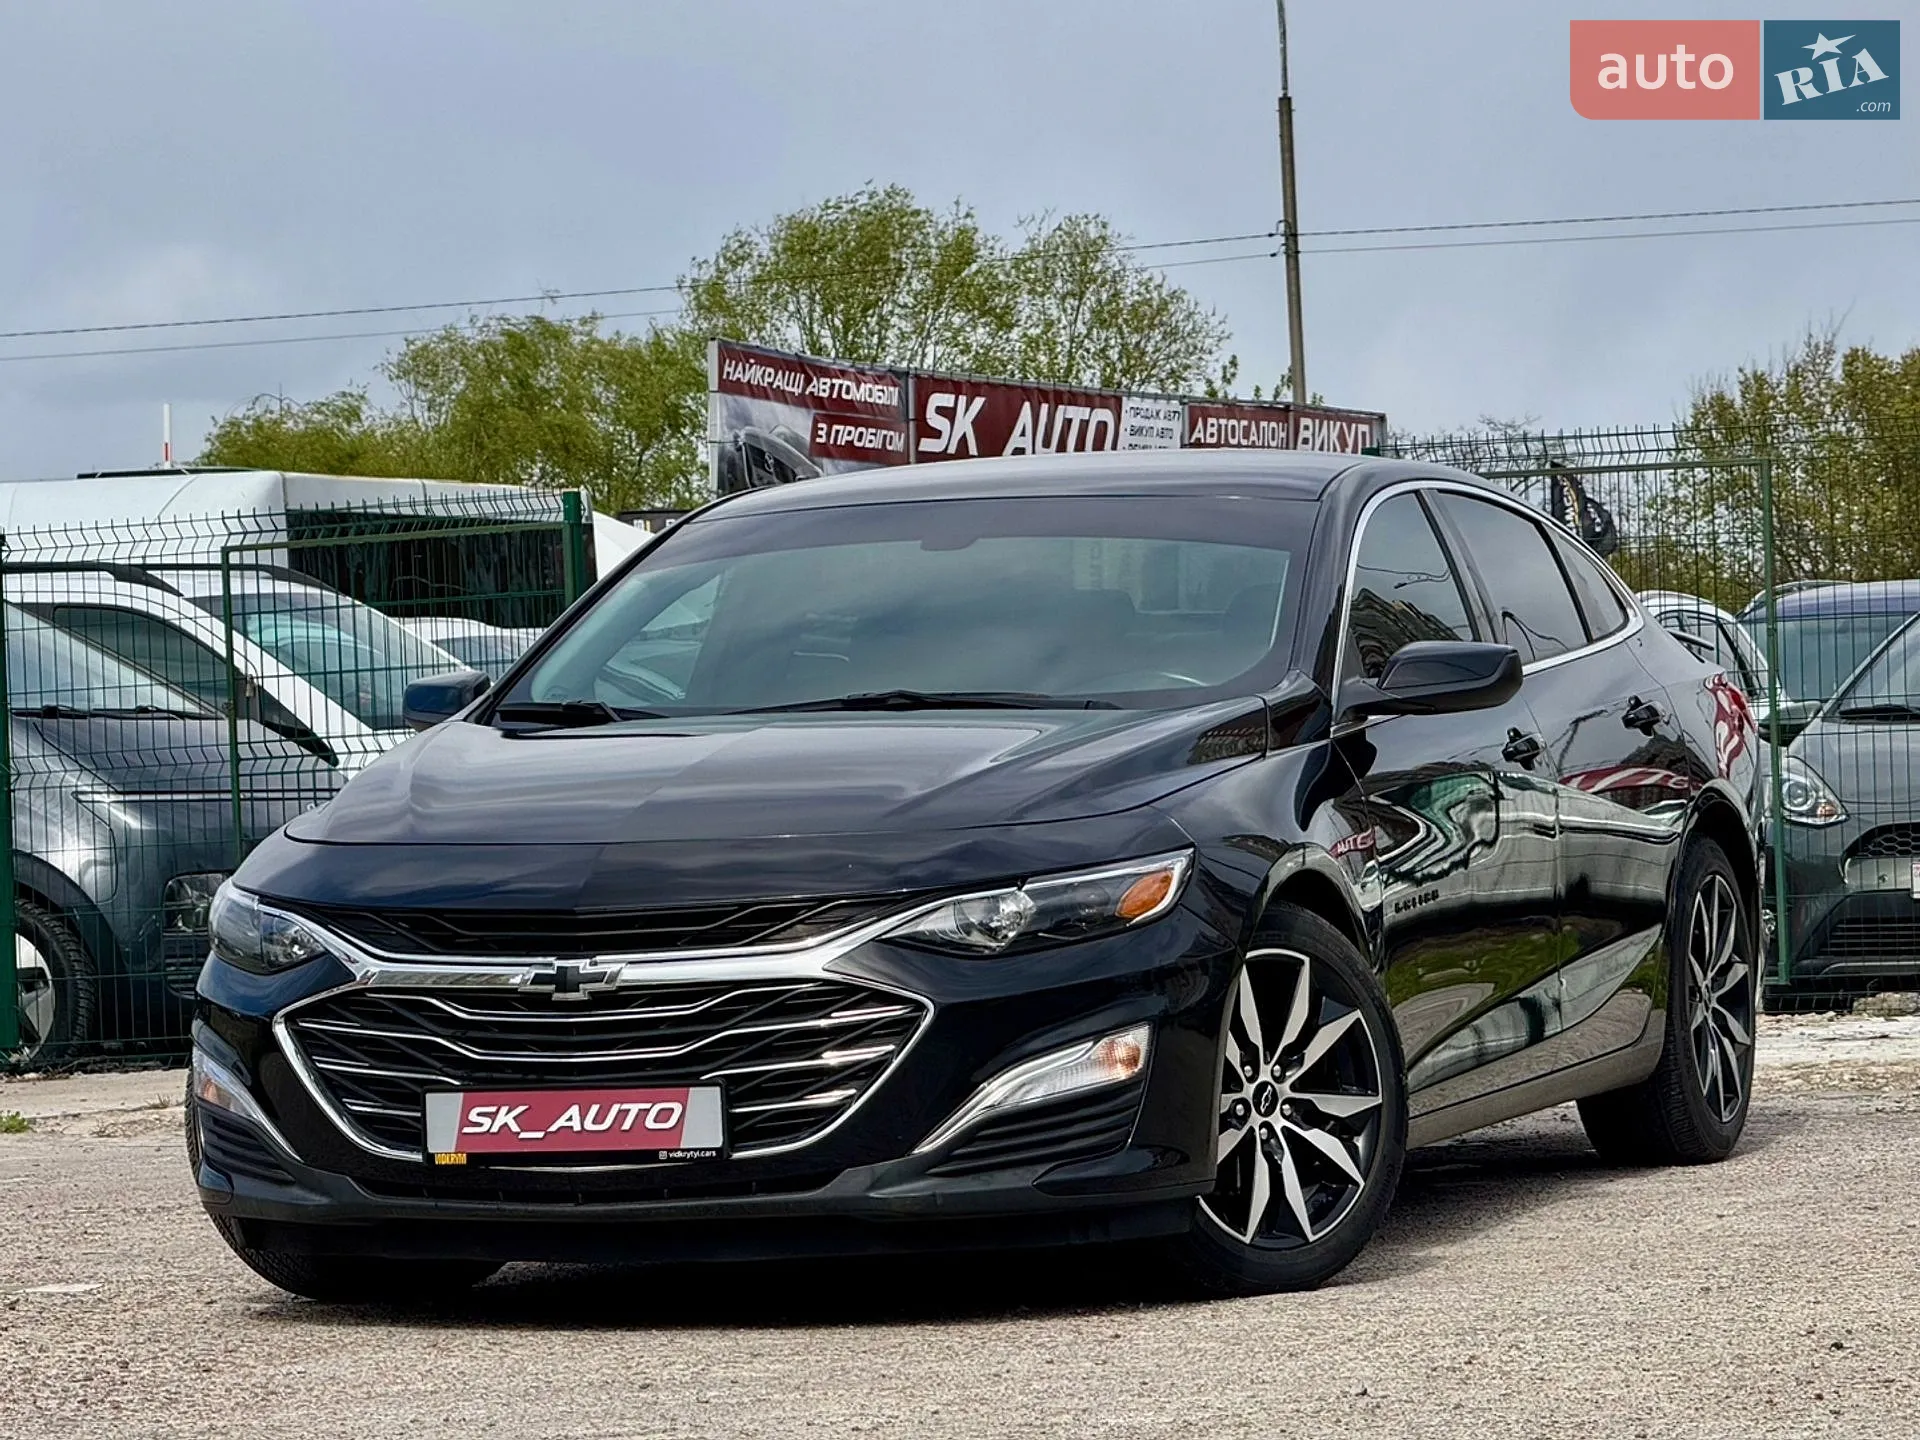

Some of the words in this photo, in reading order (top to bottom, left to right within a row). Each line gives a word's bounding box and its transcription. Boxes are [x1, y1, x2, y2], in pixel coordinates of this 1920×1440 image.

[723, 358, 805, 396] НАЙКРАЩІ
[805, 376, 899, 407] АВТОМОБІЛІ
[830, 424, 905, 452] ПРОБІГОМ
[918, 392, 987, 456] SK
[1002, 401, 1115, 456] AUTO
[1190, 416, 1288, 448] АВТОСАЛОН
[1296, 417, 1371, 455] ВИКУП
[461, 1101, 684, 1140] SK_AUTO
